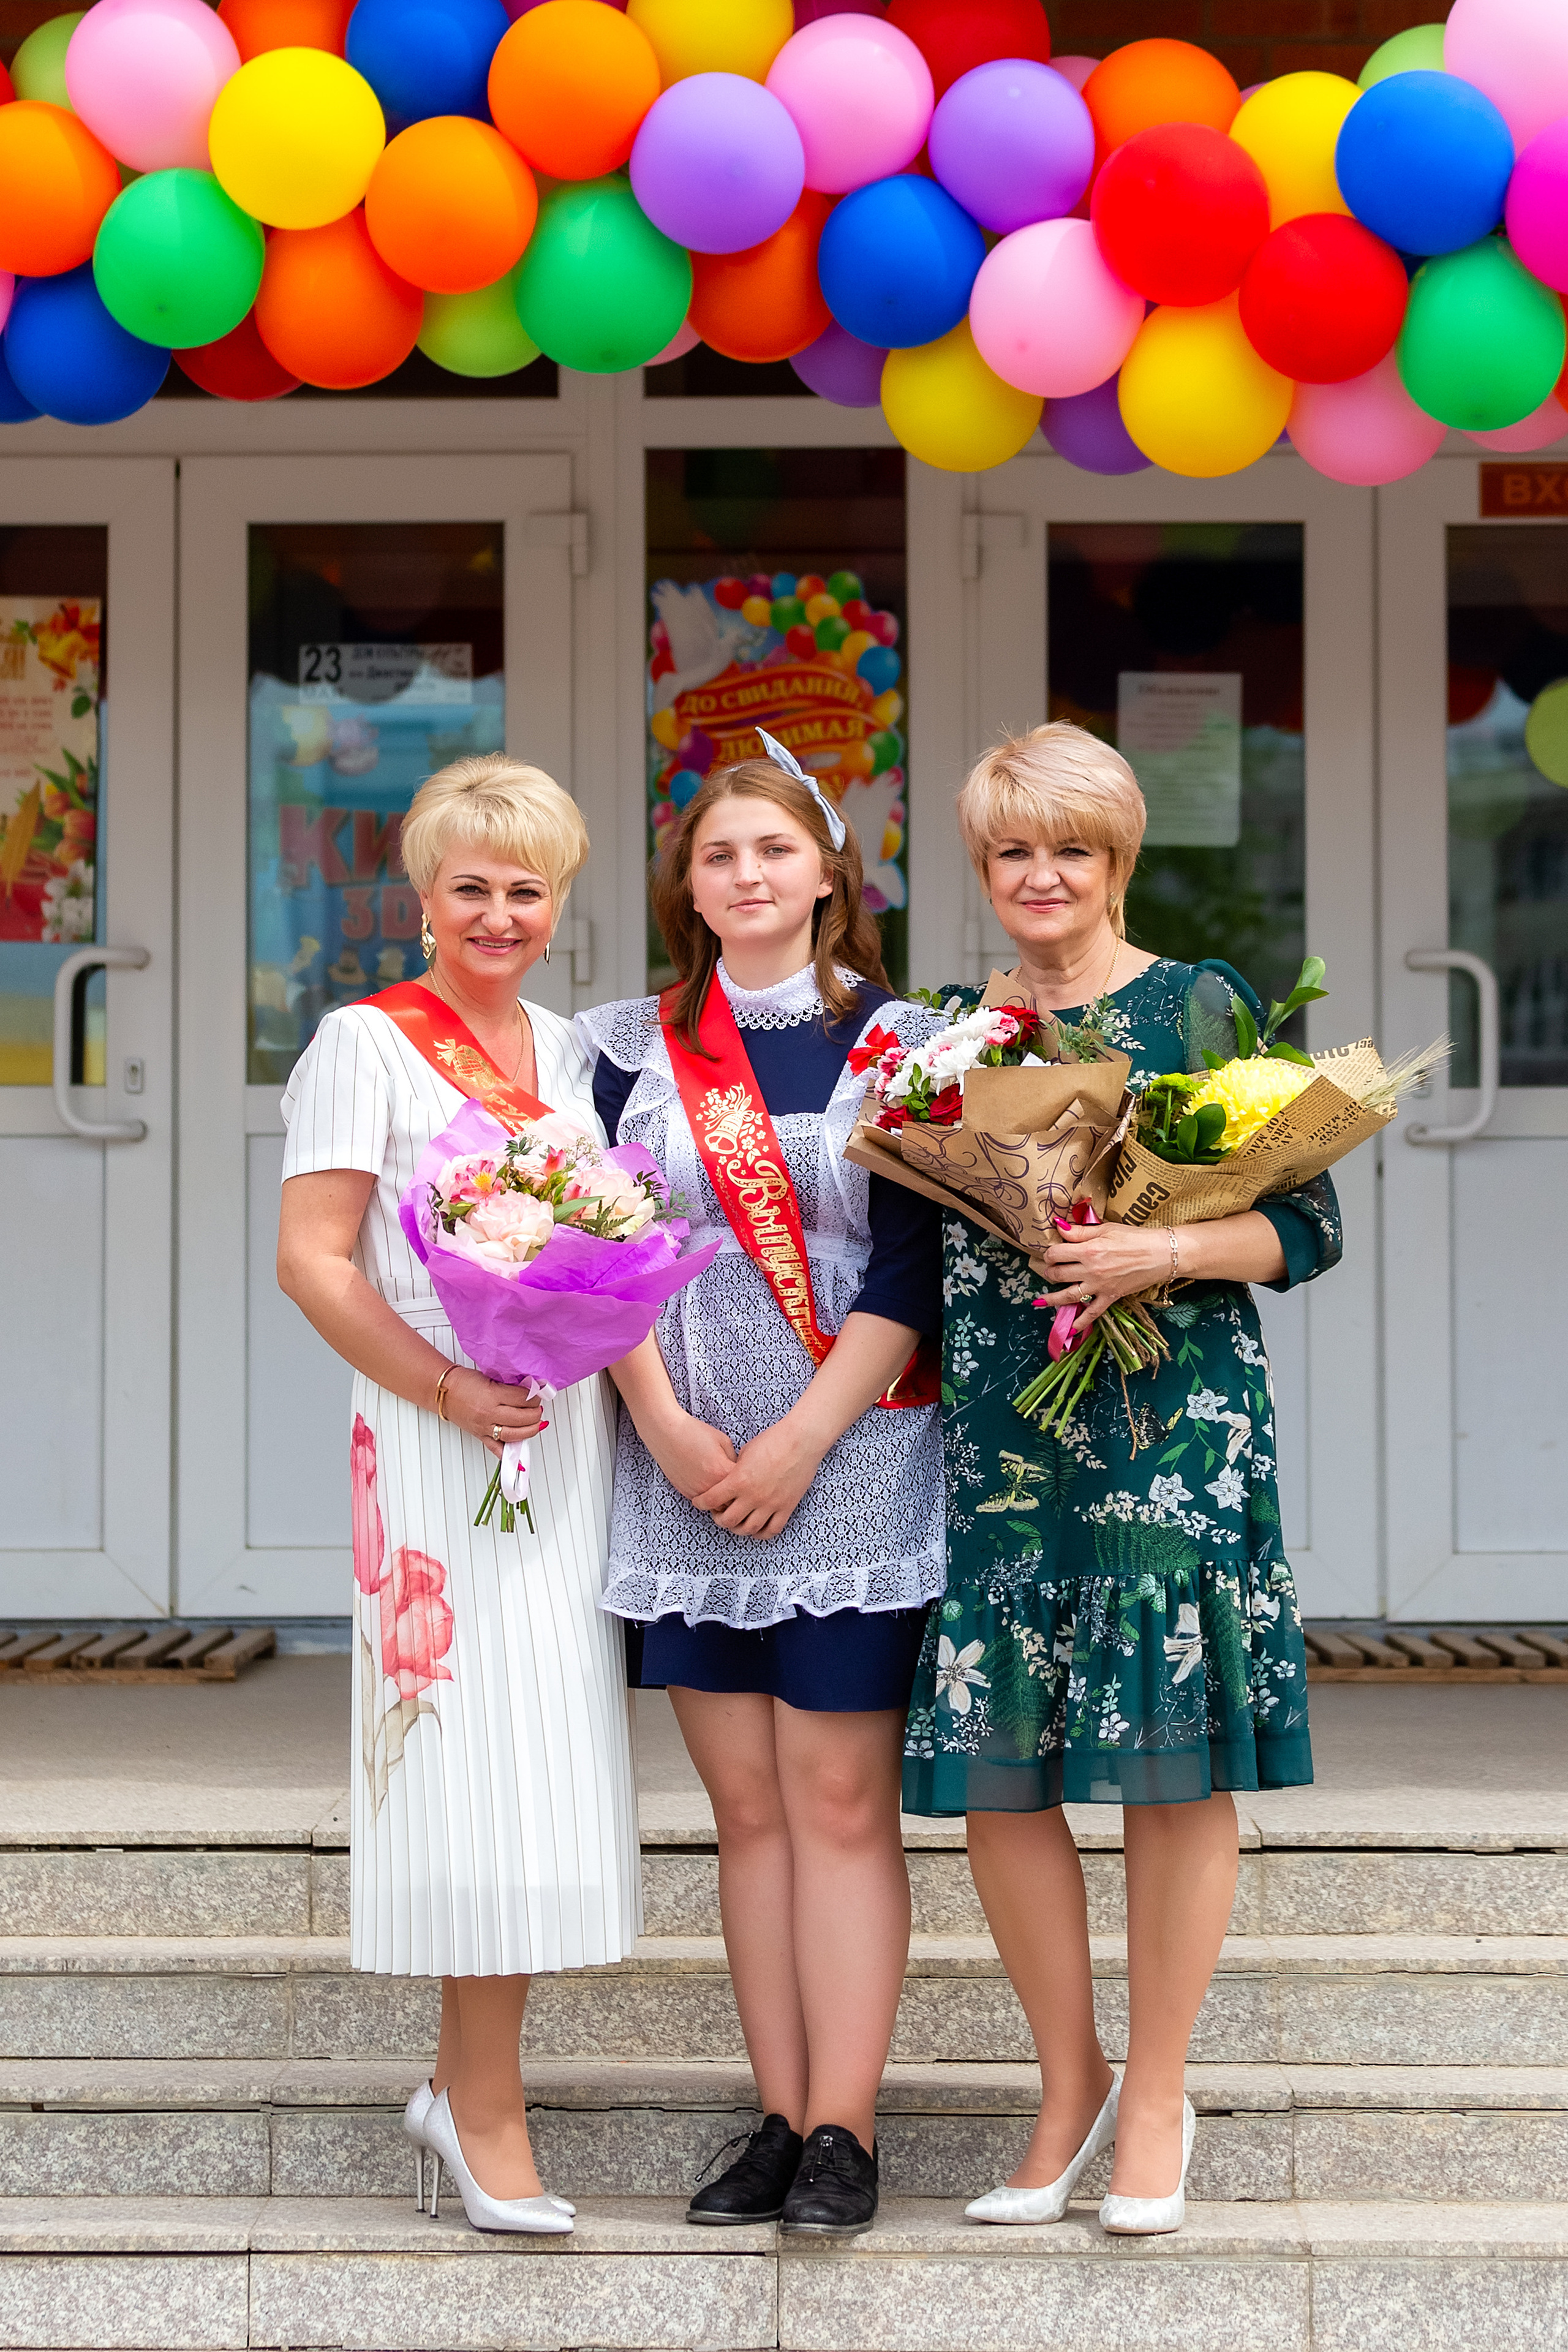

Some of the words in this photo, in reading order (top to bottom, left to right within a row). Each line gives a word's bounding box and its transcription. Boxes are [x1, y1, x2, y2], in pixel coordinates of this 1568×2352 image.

[1503, 474, 1568, 504] ВХ
[305, 646, 342, 683] 23
[680, 694, 717, 714] ДО
[718, 718, 865, 760] ЛЮИМАЯ
[341, 883, 422, 939] 3D
[1343, 1101, 1357, 1115] OF
[1265, 1117, 1280, 1133] OF
[1306, 1114, 1341, 1144] MAGIC
[1243, 1133, 1268, 1158] MAG
